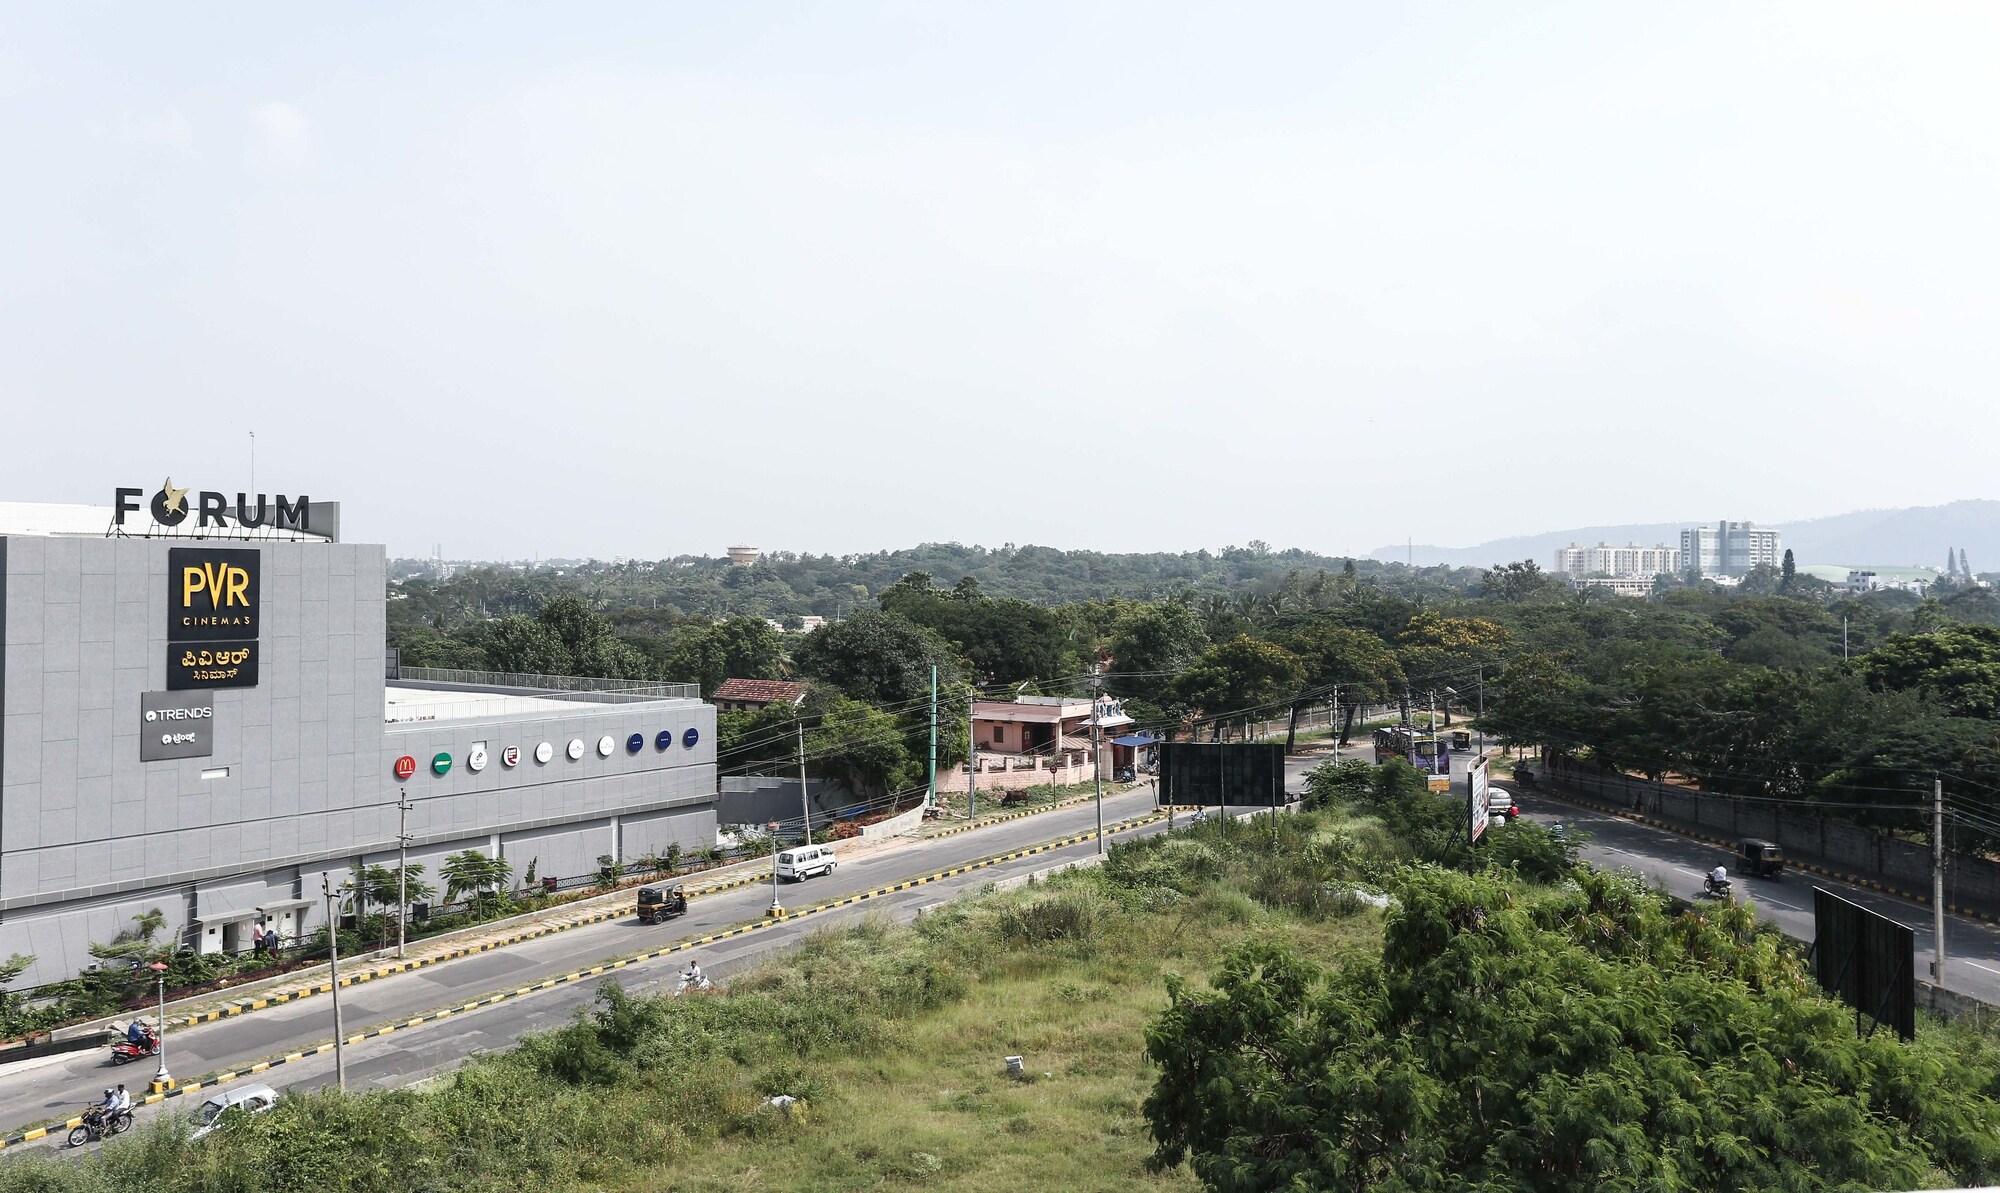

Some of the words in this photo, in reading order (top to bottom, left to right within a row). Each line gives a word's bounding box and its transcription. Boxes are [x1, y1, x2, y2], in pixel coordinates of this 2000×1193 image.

[115, 486, 309, 530] FORUM
[183, 562, 250, 611] PVR
[183, 616, 250, 626] CINEMAS
[157, 707, 212, 720] TRENDS
